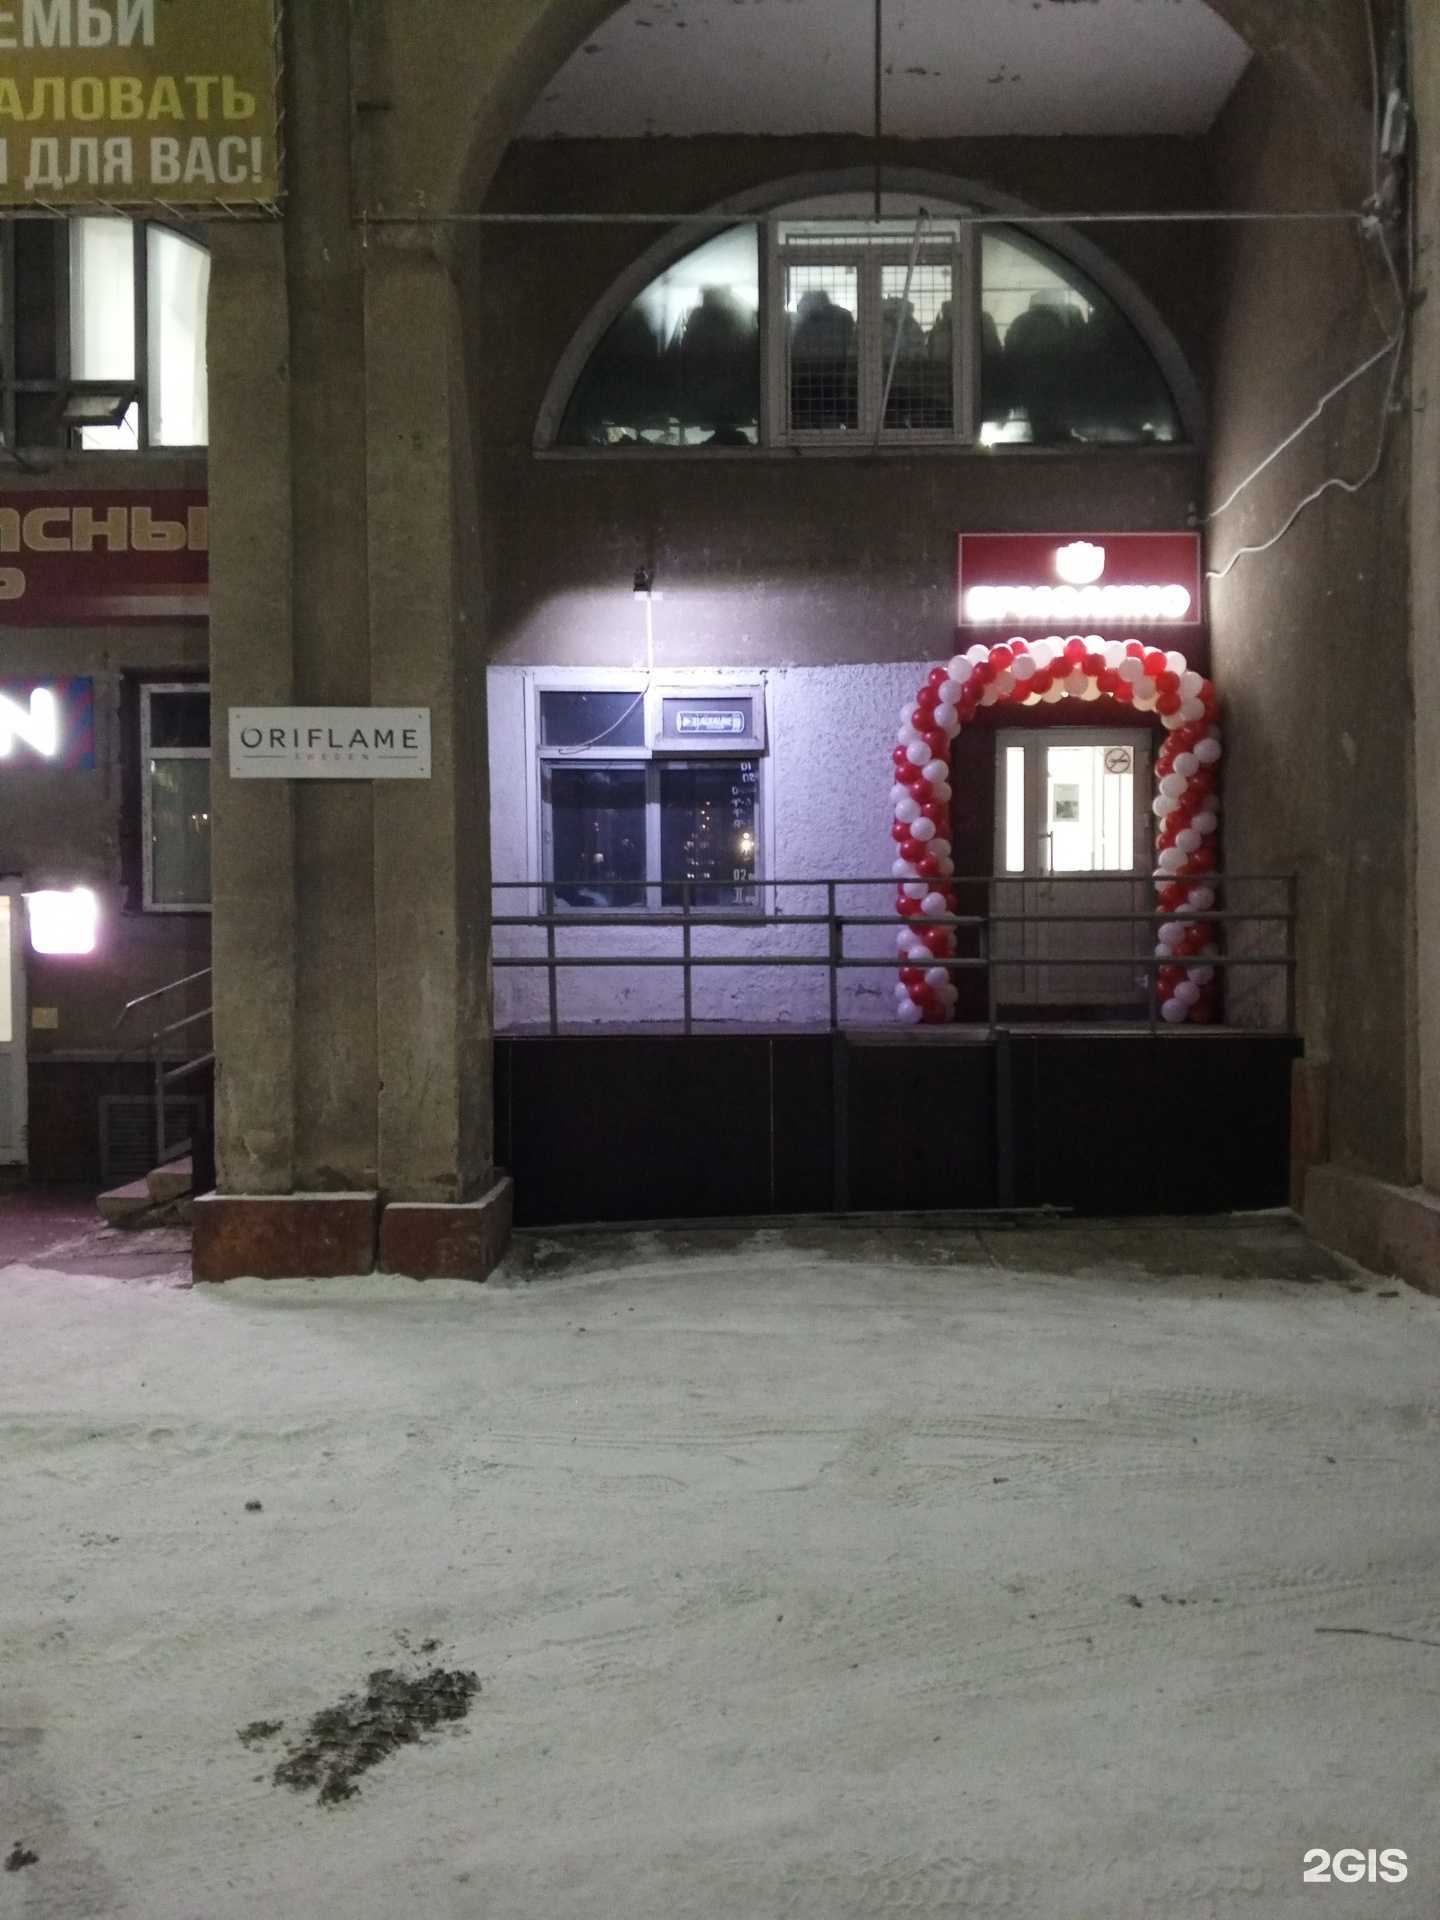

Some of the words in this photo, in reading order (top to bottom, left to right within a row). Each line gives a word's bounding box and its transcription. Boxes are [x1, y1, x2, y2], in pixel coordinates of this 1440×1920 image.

[0, 76, 256, 121] АЛОВАТЬ
[24, 136, 133, 190] ДЛЯ
[151, 136, 263, 184] ВАС!
[240, 727, 418, 749] ORIFLAME
